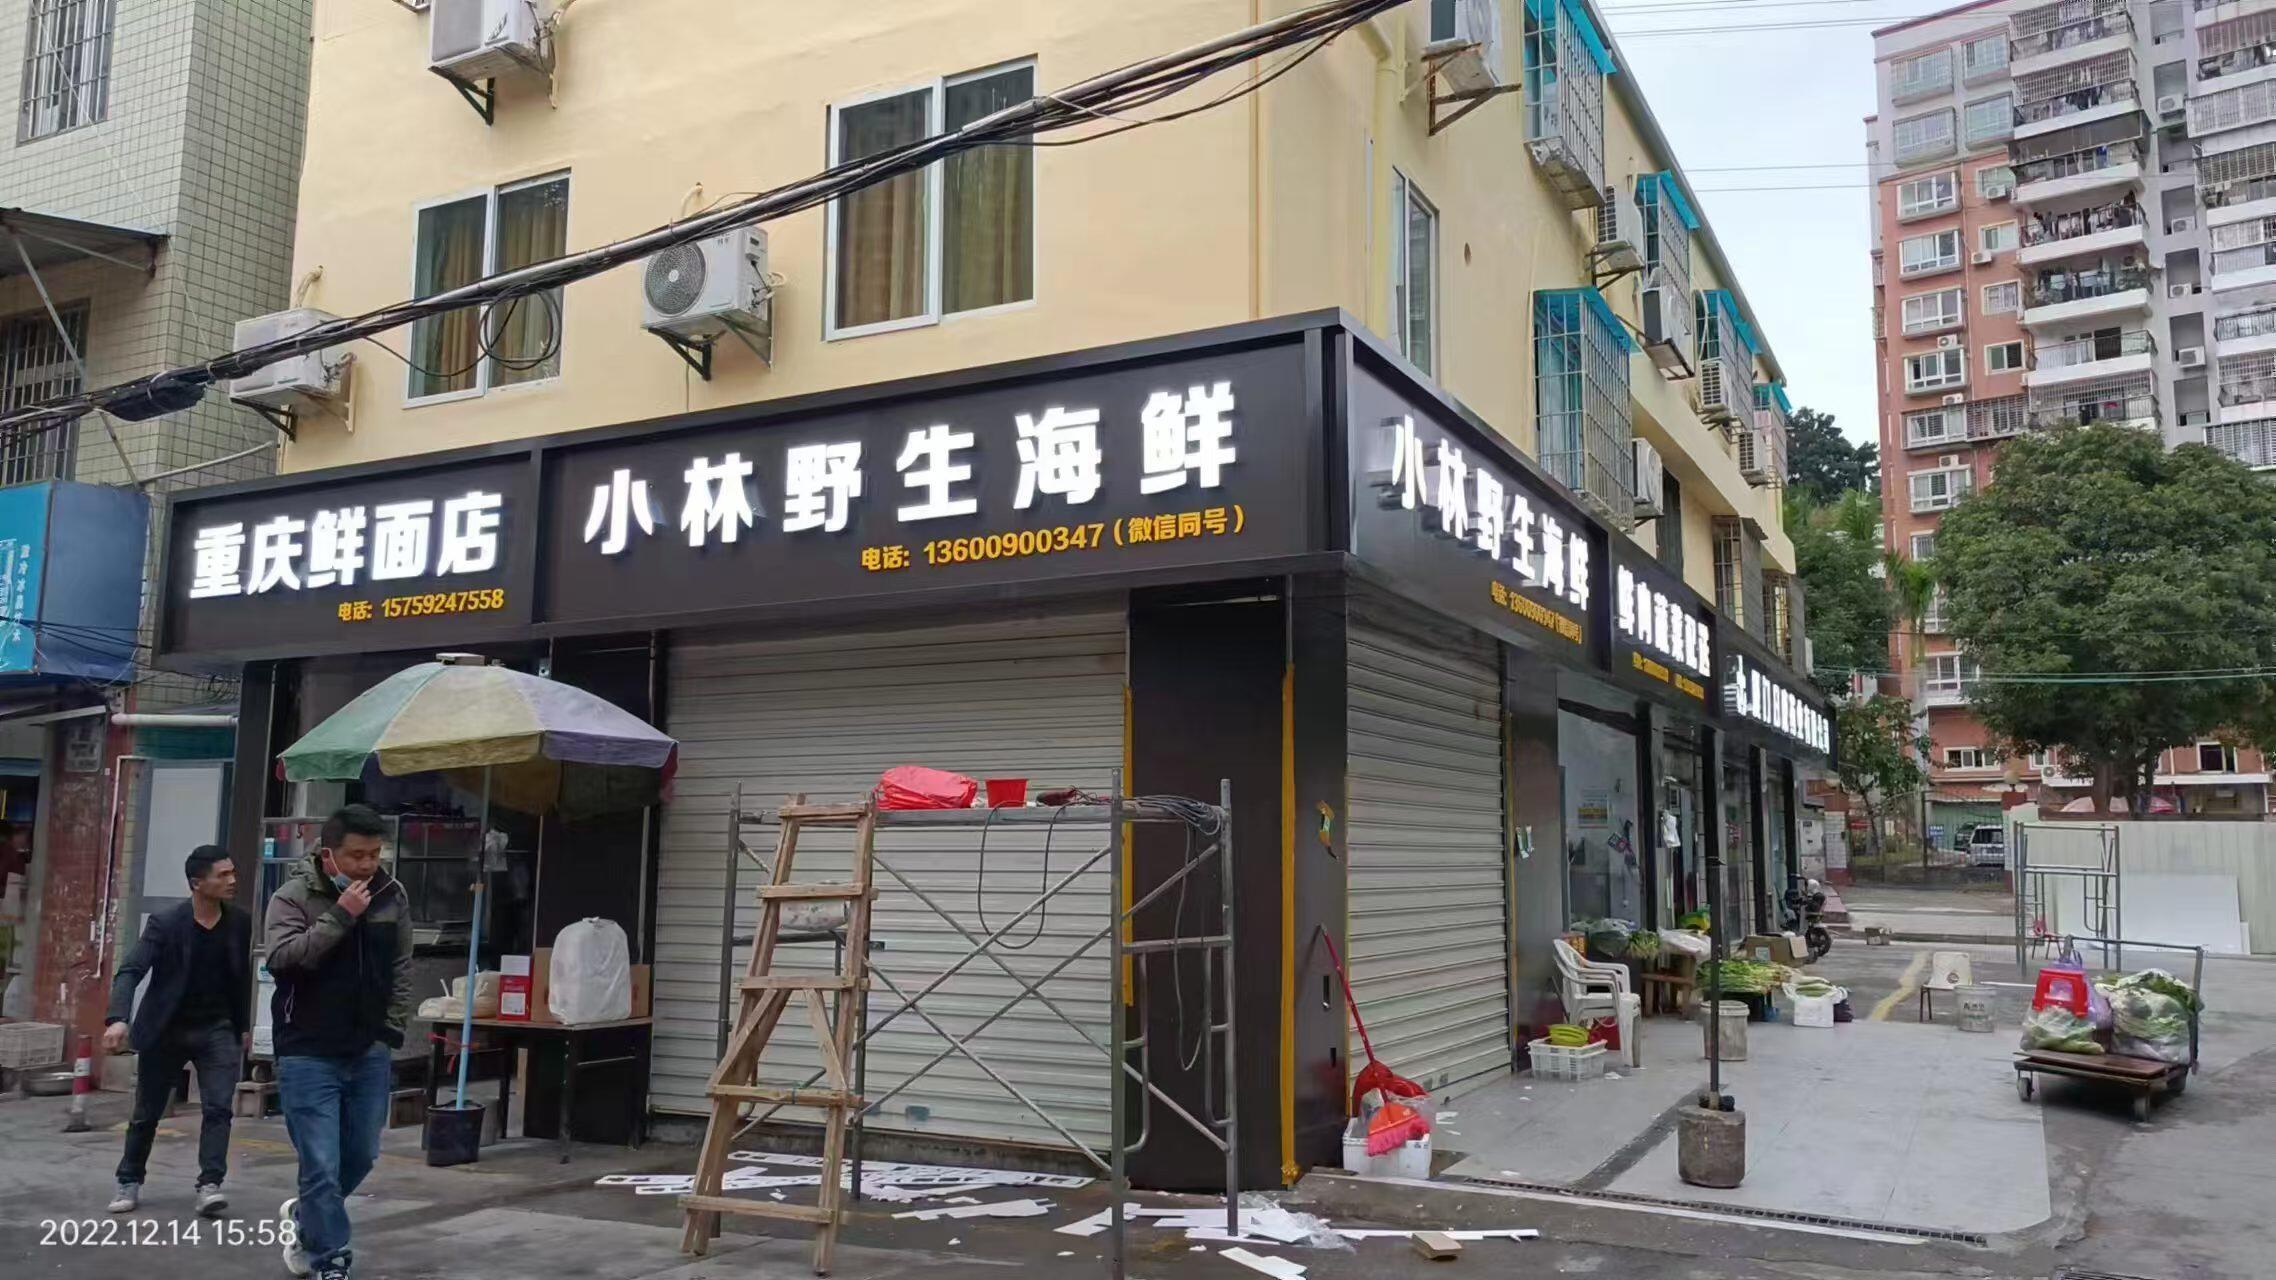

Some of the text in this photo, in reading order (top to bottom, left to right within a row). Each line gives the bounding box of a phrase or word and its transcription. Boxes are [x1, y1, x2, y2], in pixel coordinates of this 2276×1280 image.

[189, 491, 502, 599] 重庆鲜面店
[584, 381, 1236, 554] 小林野生海鲜
[1391, 414, 1589, 611] 小林野生海鲜
